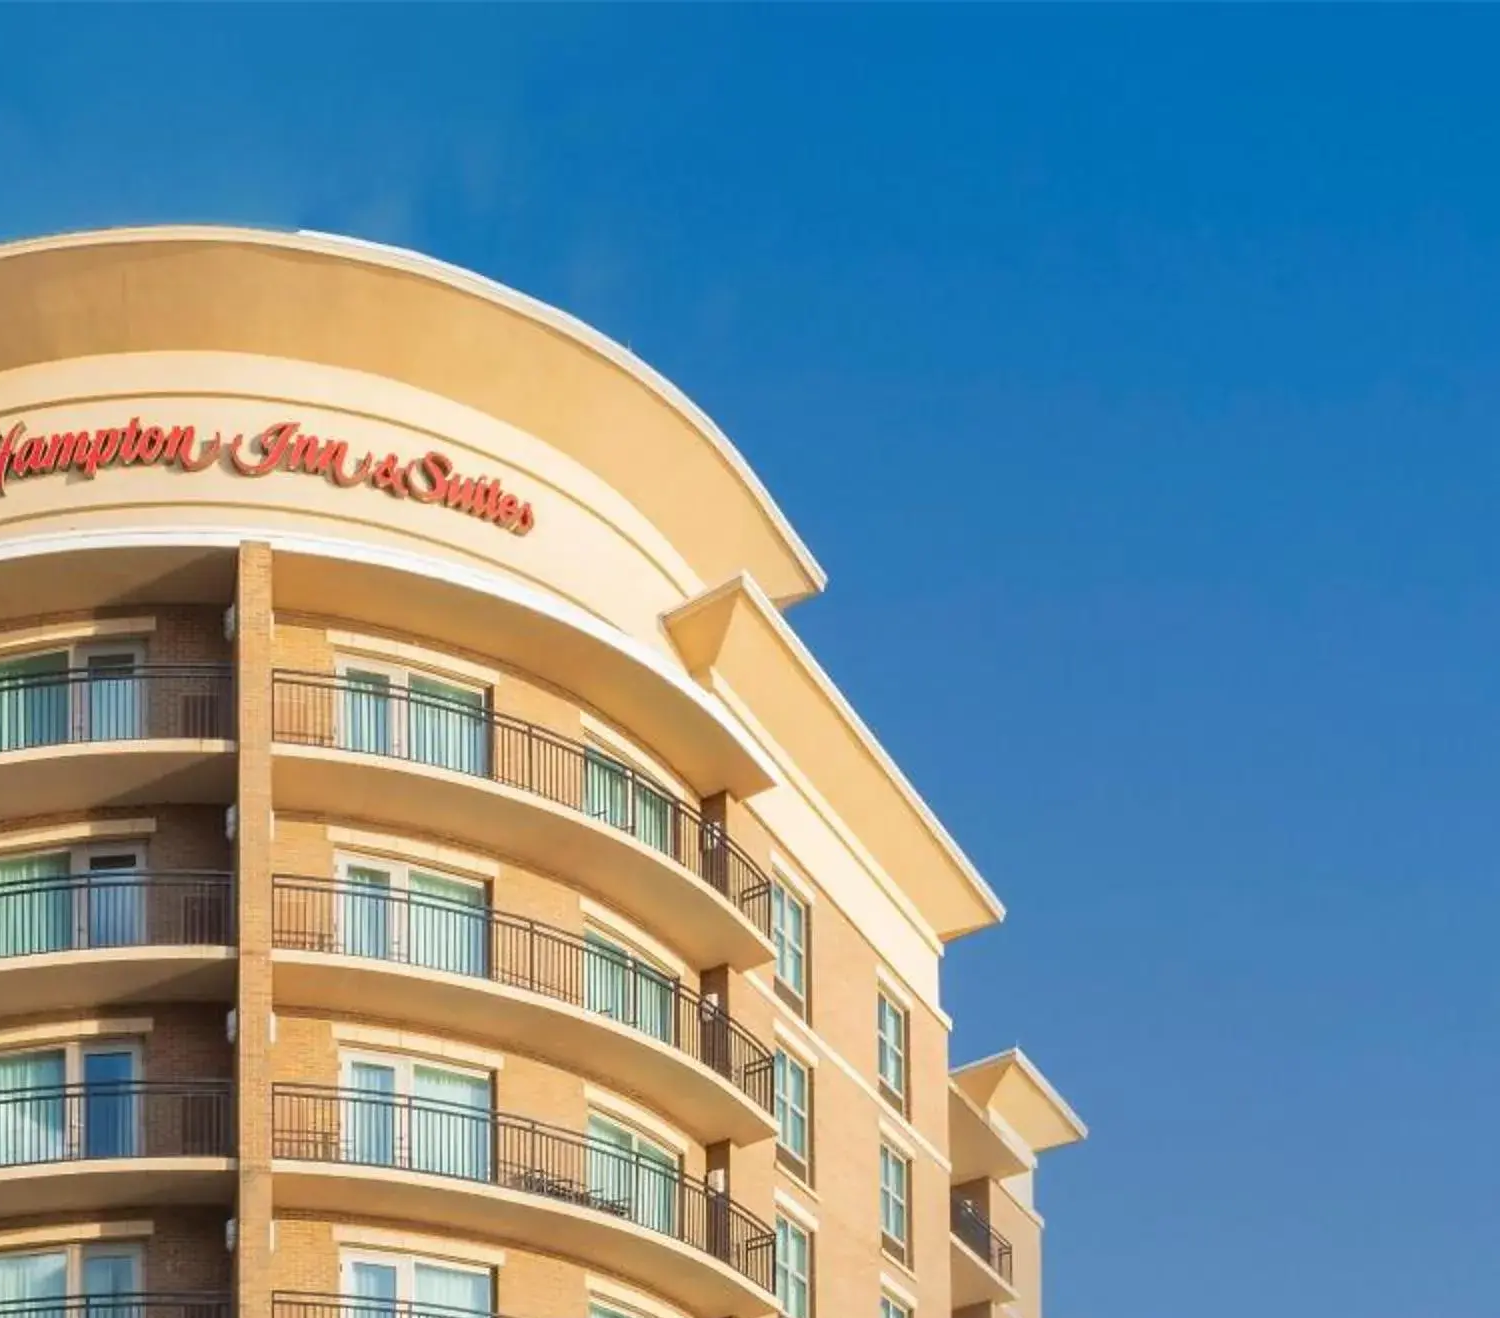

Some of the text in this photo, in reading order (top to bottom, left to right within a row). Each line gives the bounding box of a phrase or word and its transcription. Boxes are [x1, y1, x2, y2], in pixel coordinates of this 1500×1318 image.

[231, 422, 373, 488] Inn
[372, 453, 407, 500] &
[405, 451, 534, 537] Suites
